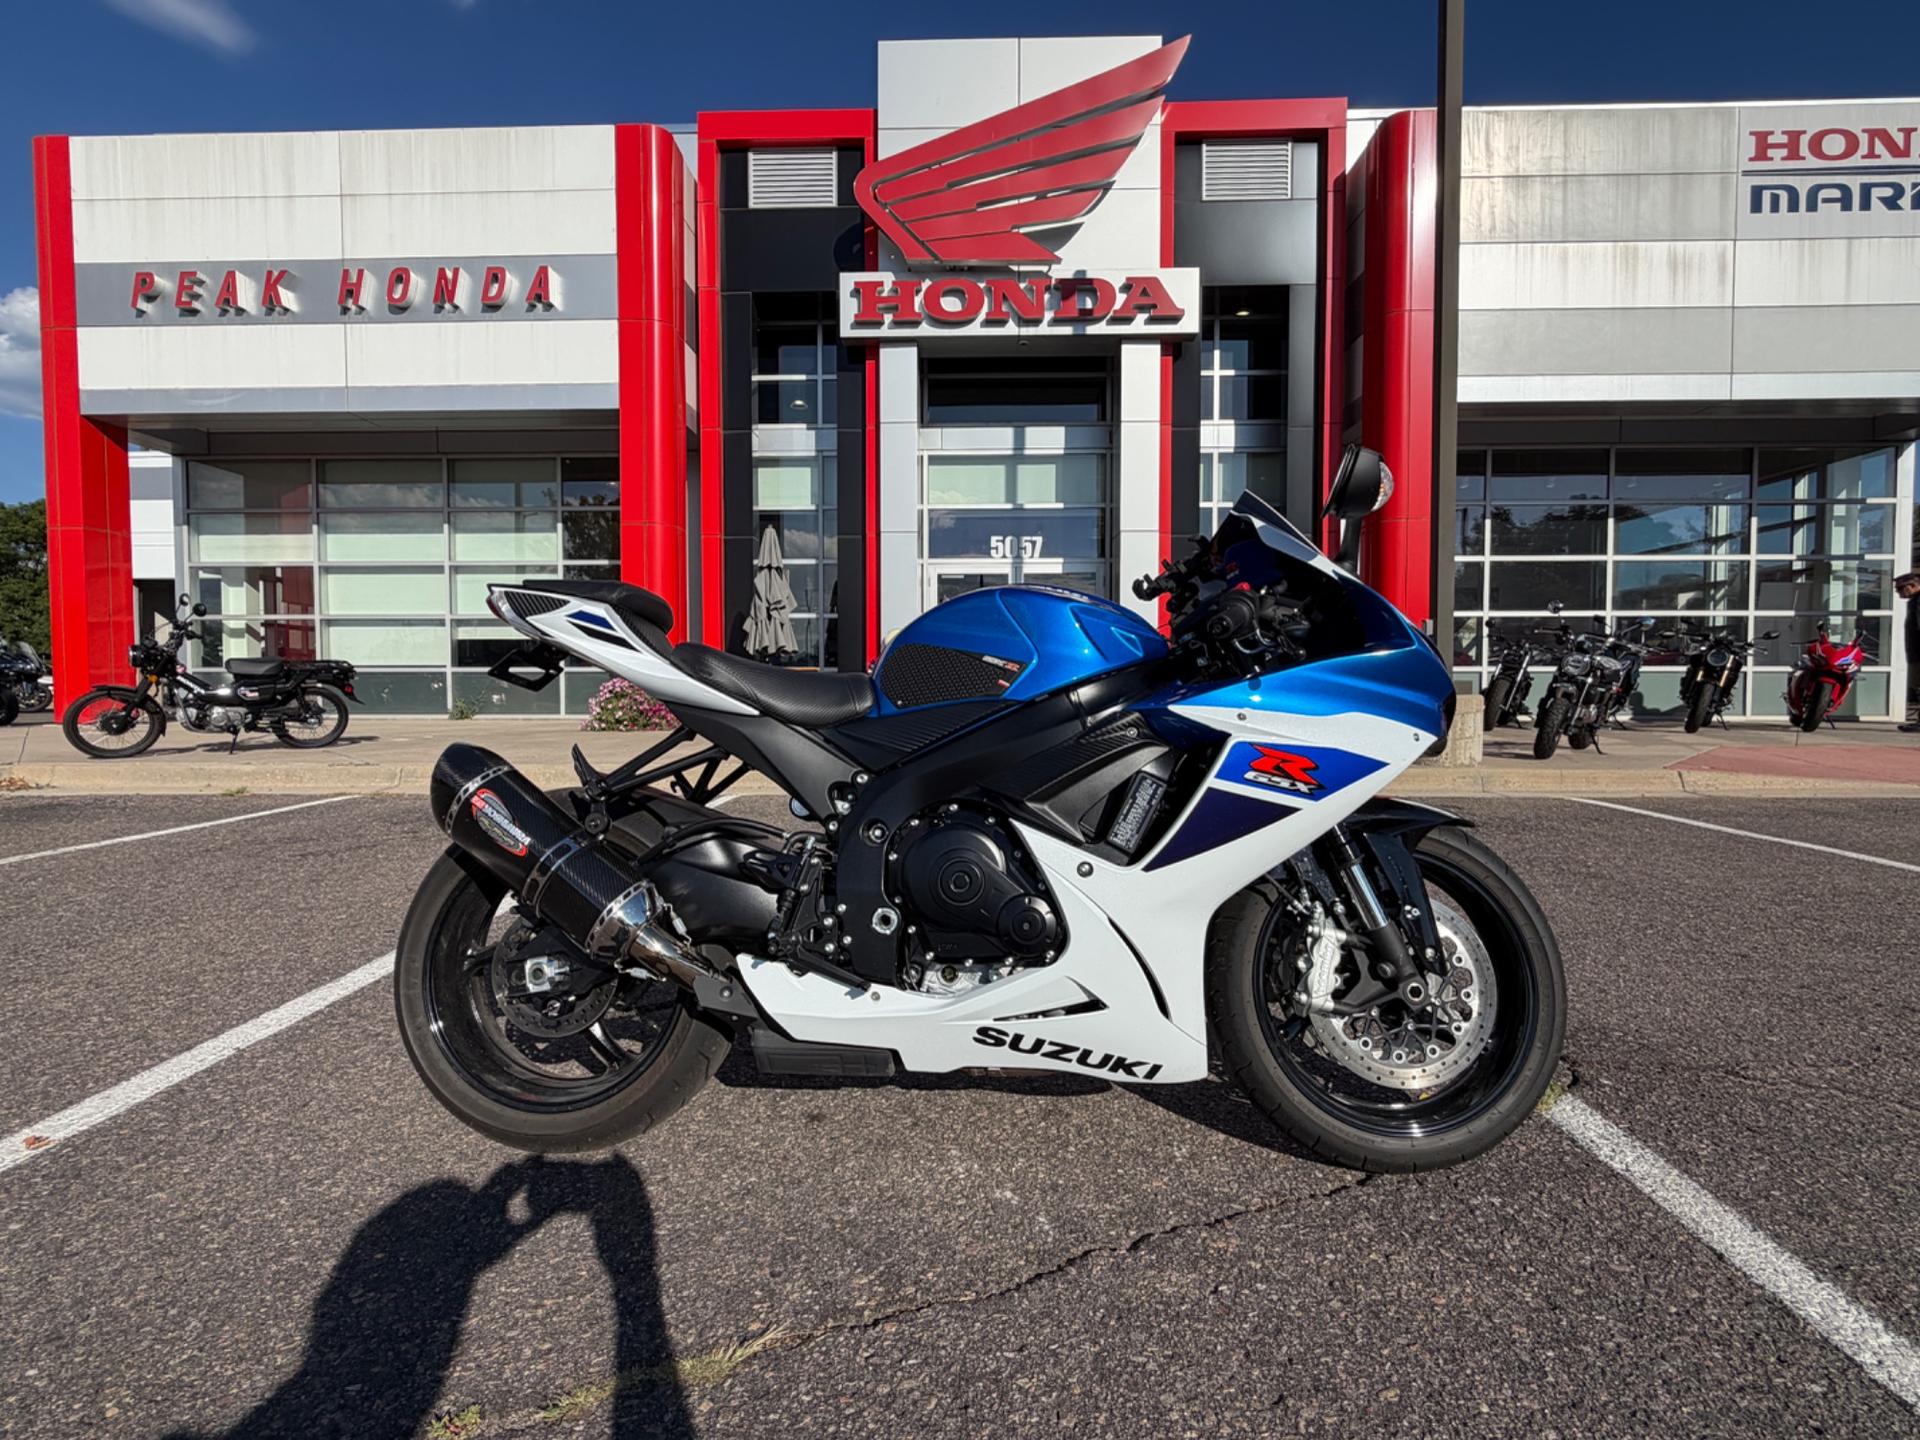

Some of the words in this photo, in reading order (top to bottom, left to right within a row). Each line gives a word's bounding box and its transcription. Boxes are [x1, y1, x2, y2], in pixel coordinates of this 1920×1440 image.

[1748, 127, 1920, 162] HON
[130, 269, 288, 309] PEAK
[337, 265, 551, 305] HONDA
[853, 275, 1186, 322] HONDA
[990, 535, 1043, 559] 5057
[972, 1026, 1164, 1081] SUZUKI
